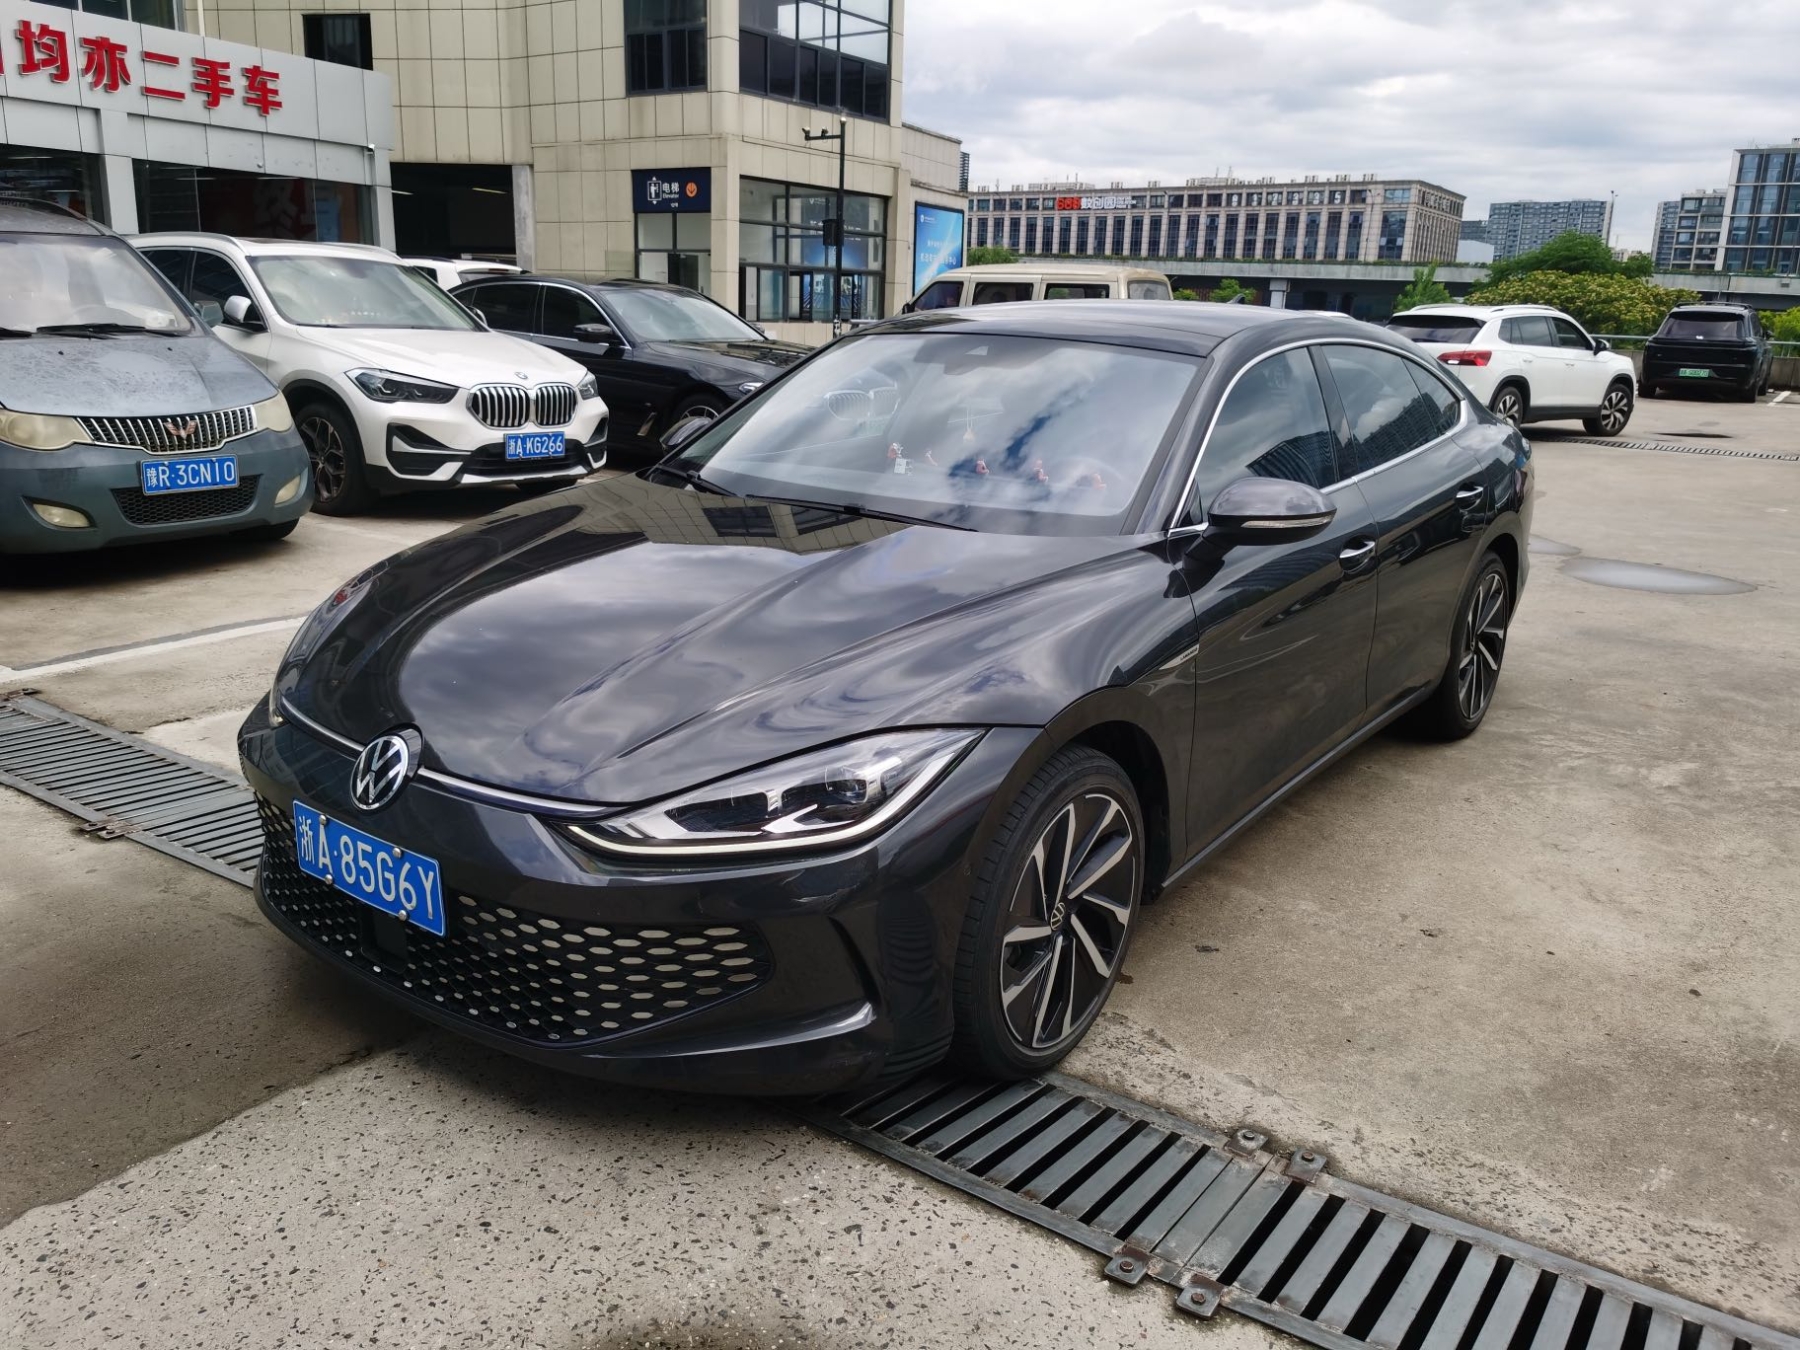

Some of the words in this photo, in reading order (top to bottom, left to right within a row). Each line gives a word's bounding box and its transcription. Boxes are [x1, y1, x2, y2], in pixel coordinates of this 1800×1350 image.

[0, 19, 283, 116] 均亦二手车
[662, 181, 680, 193] 电梯
